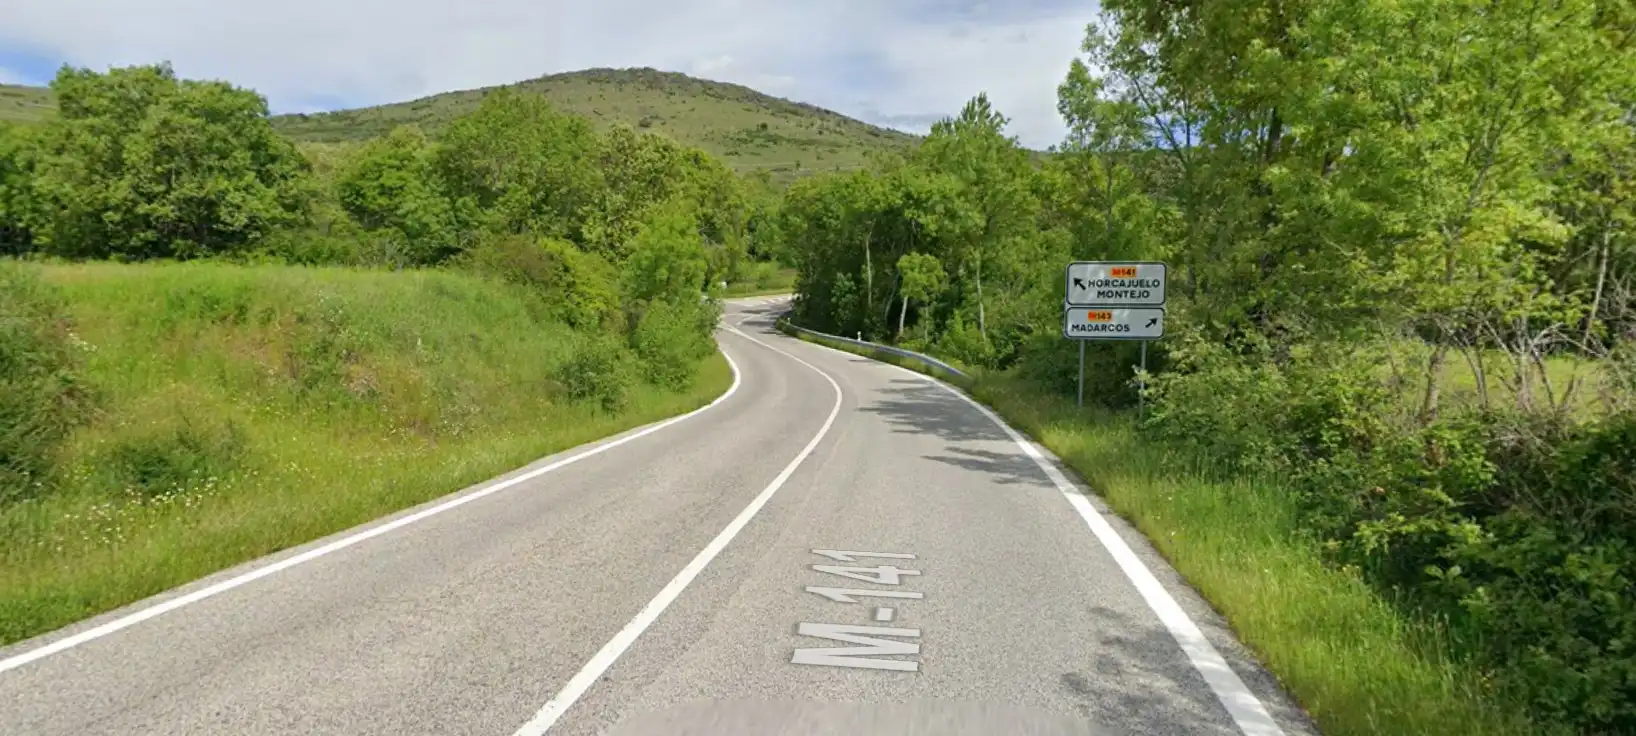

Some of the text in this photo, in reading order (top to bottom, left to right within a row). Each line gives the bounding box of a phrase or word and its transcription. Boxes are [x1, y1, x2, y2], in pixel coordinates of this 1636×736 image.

[1088, 279, 1160, 288] HORCAJUELO
[1097, 290, 1150, 298] MONTEJO
[1071, 323, 1130, 332] MADARCOS
